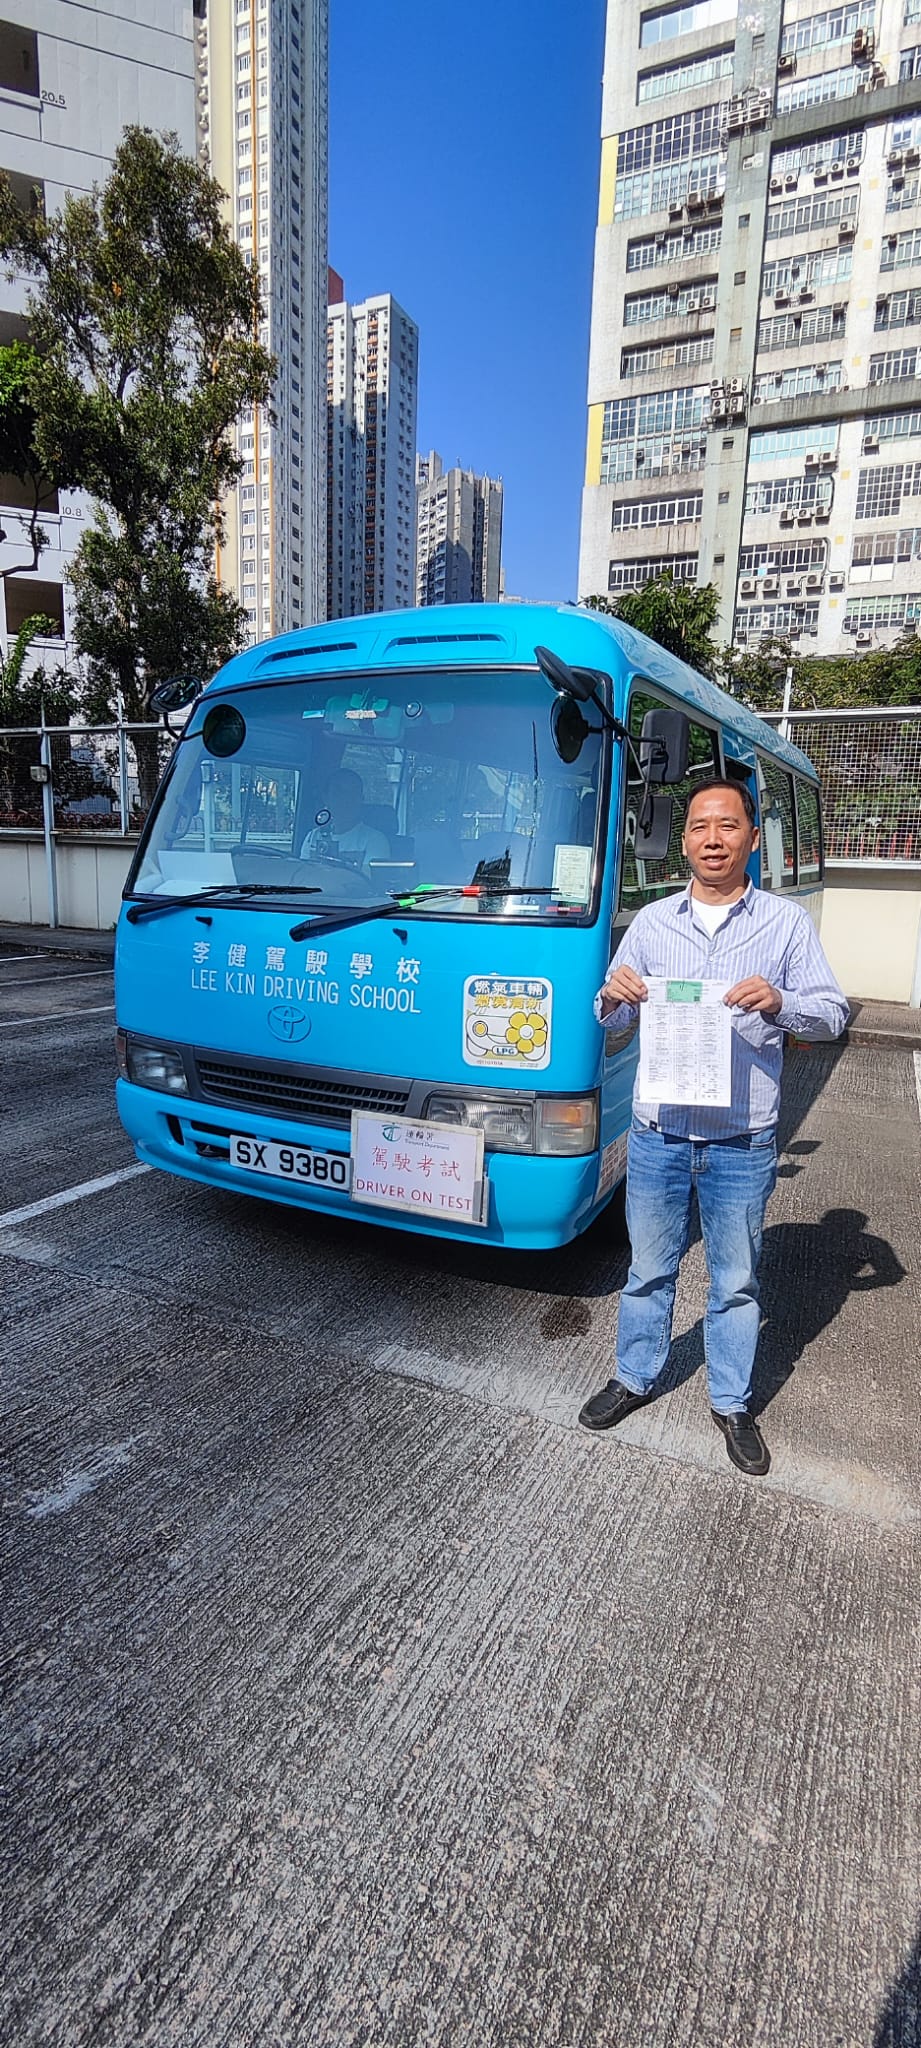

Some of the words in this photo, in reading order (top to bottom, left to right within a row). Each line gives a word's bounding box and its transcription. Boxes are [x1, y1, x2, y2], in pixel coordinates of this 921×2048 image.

[41, 90, 66, 105] 20.5
[62, 506, 82, 517] 10.8
[192, 941, 421, 985] 李健駕駛學校
[191, 968, 218, 992] LEE
[225, 972, 255, 996] KIN
[263, 975, 340, 1005] DRIVING
[349, 984, 421, 1014] SCHOOL
[496, 1047, 515, 1055] LPG
[236, 1140, 268, 1169] SX
[279, 1149, 346, 1185] 9380
[371, 1145, 461, 1182] 駕駛考試
[356, 1178, 405, 1199] DRIVER
[411, 1189, 433, 1204] ON
[439, 1193, 472, 1211] TEST
